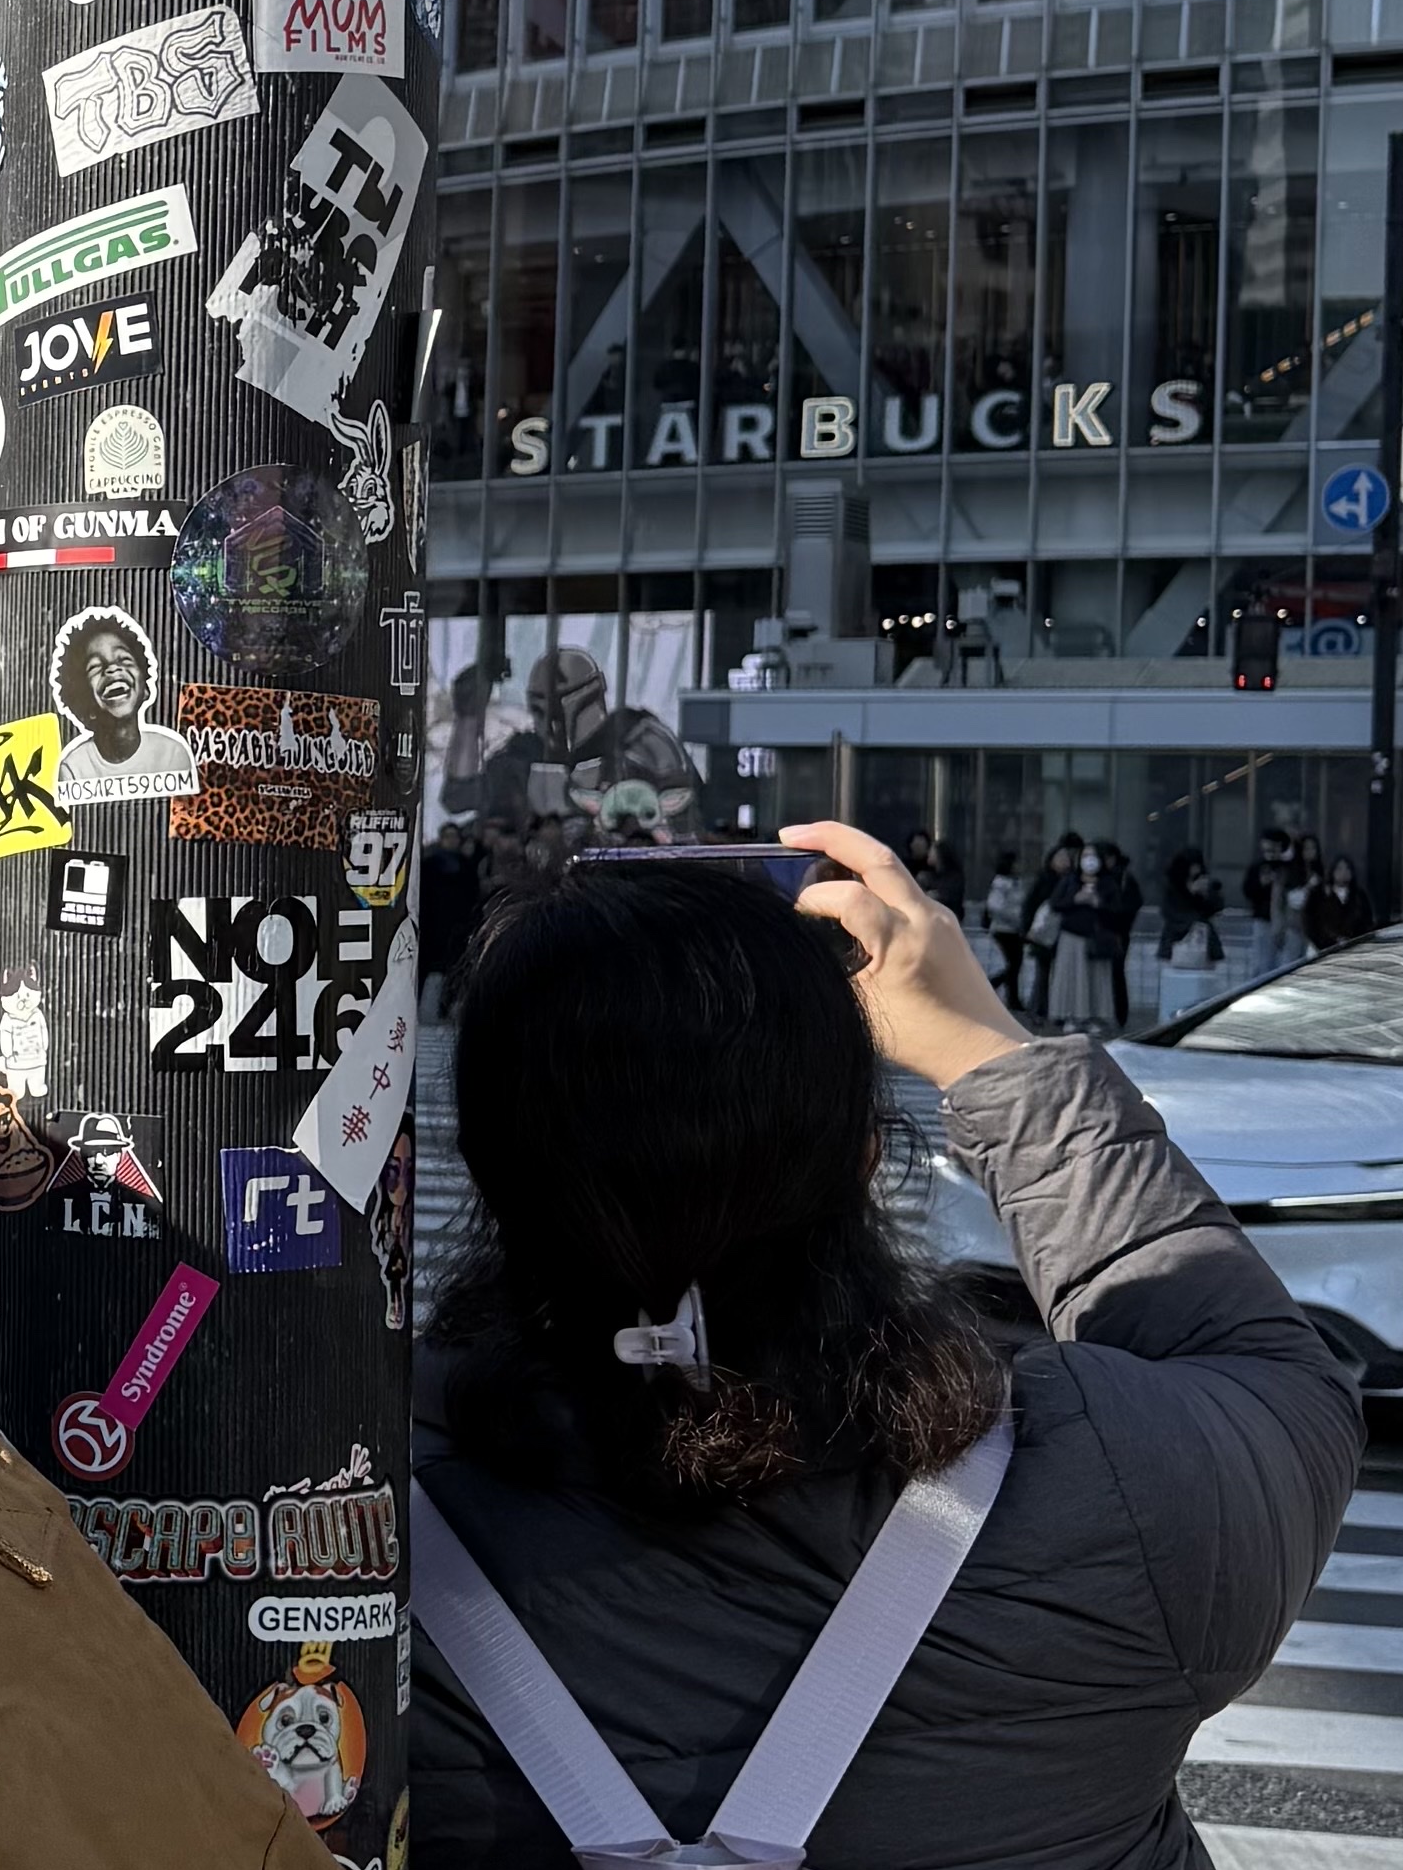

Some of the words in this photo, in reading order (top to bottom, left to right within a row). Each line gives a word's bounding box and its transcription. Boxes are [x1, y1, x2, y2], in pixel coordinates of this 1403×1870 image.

[286, 28, 386, 55] FILMS
[55, 11, 242, 154] TBS
[20, 303, 154, 382] JOVE
[100, 408, 157, 431] ESPRESSO
[510, 380, 1204, 476] STARBUCKS
[89, 473, 162, 490] CAPPUCCINO
[12, 515, 47, 545] OF
[54, 508, 180, 541] GUNMA
[350, 814, 405, 831] RUFFIN
[345, 831, 408, 887] 97
[151, 979, 375, 1073] 246
[120, 1288, 197, 1404] Syndrome
[257, 1601, 393, 1634] GENSPARK
